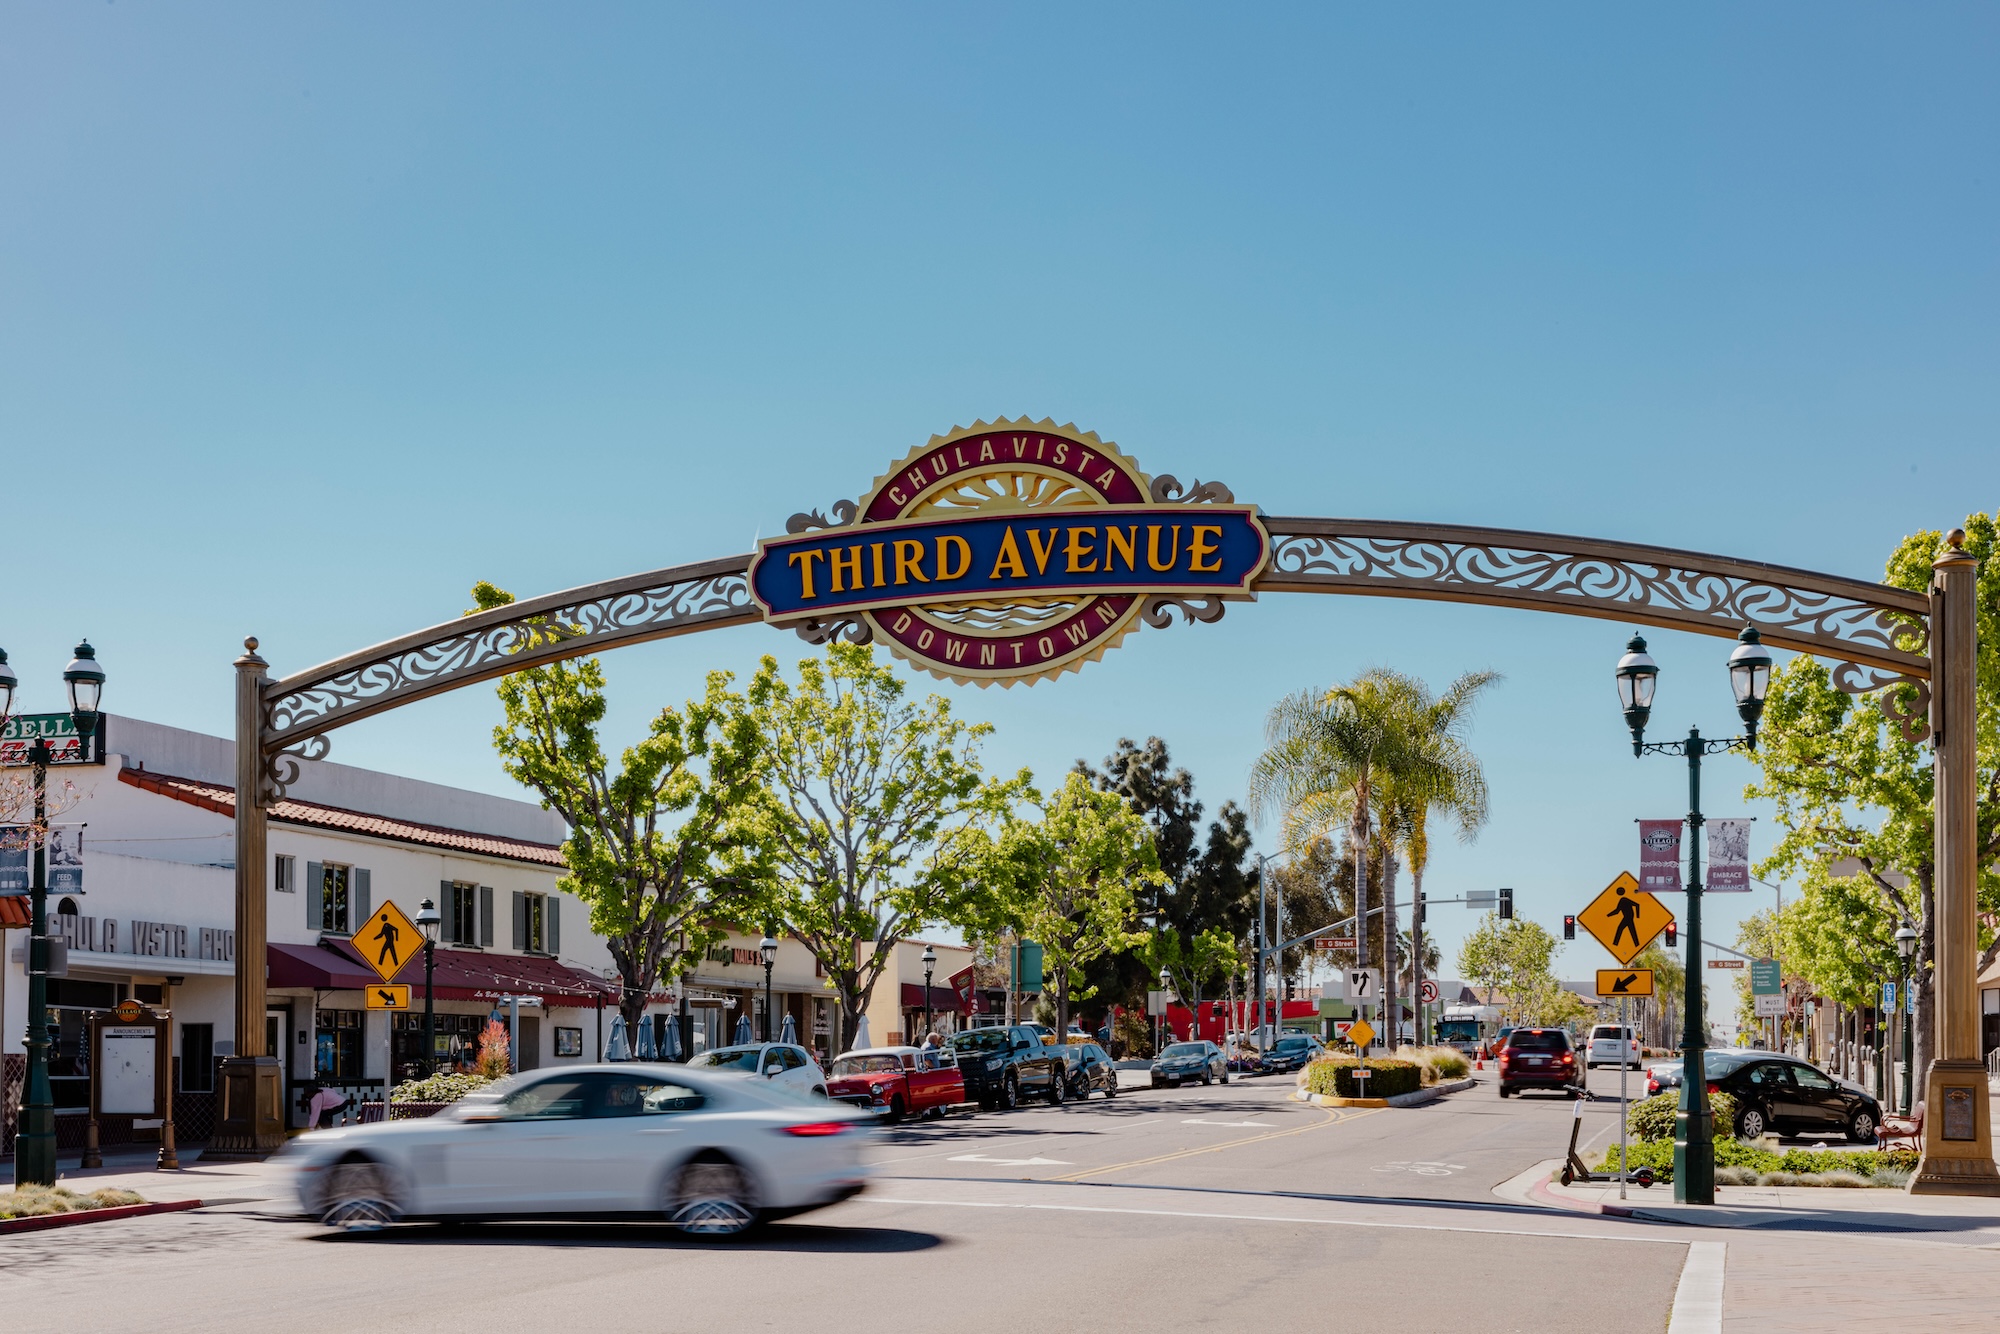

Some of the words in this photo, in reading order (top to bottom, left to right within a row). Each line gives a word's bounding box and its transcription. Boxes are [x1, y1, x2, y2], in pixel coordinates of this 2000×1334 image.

[887, 439, 996, 506] CHULA
[1013, 436, 1117, 491] VISTA
[788, 535, 973, 599] THIRD
[988, 524, 1223, 580] AVENUE
[893, 600, 1119, 666] DOWNTOWN
[56, 873, 73, 881] FEED
[131, 920, 188, 958] VISTA
